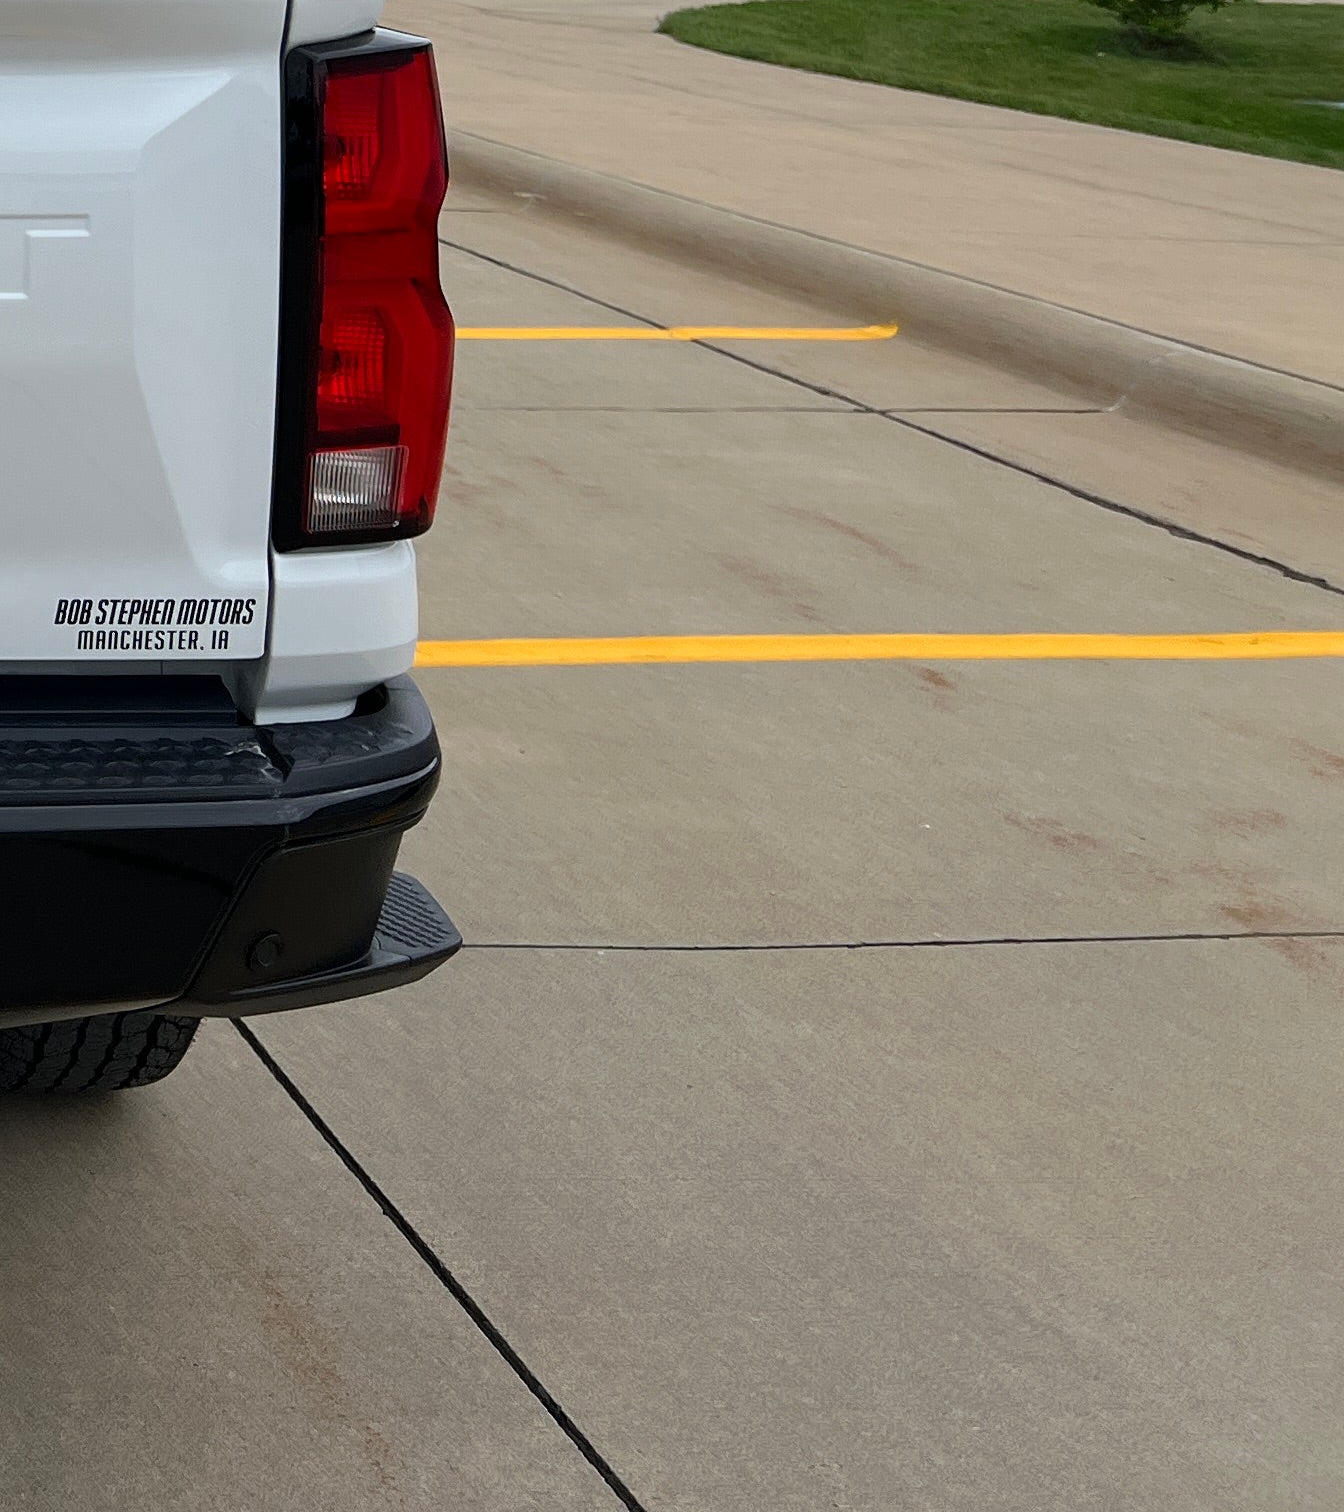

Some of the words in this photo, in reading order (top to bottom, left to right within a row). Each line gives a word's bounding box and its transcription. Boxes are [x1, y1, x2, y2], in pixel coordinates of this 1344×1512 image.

[54, 599, 93, 625] BOB
[95, 599, 175, 625] STEPHEN
[176, 599, 256, 625] MOTORS
[211, 630, 229, 650] IA
